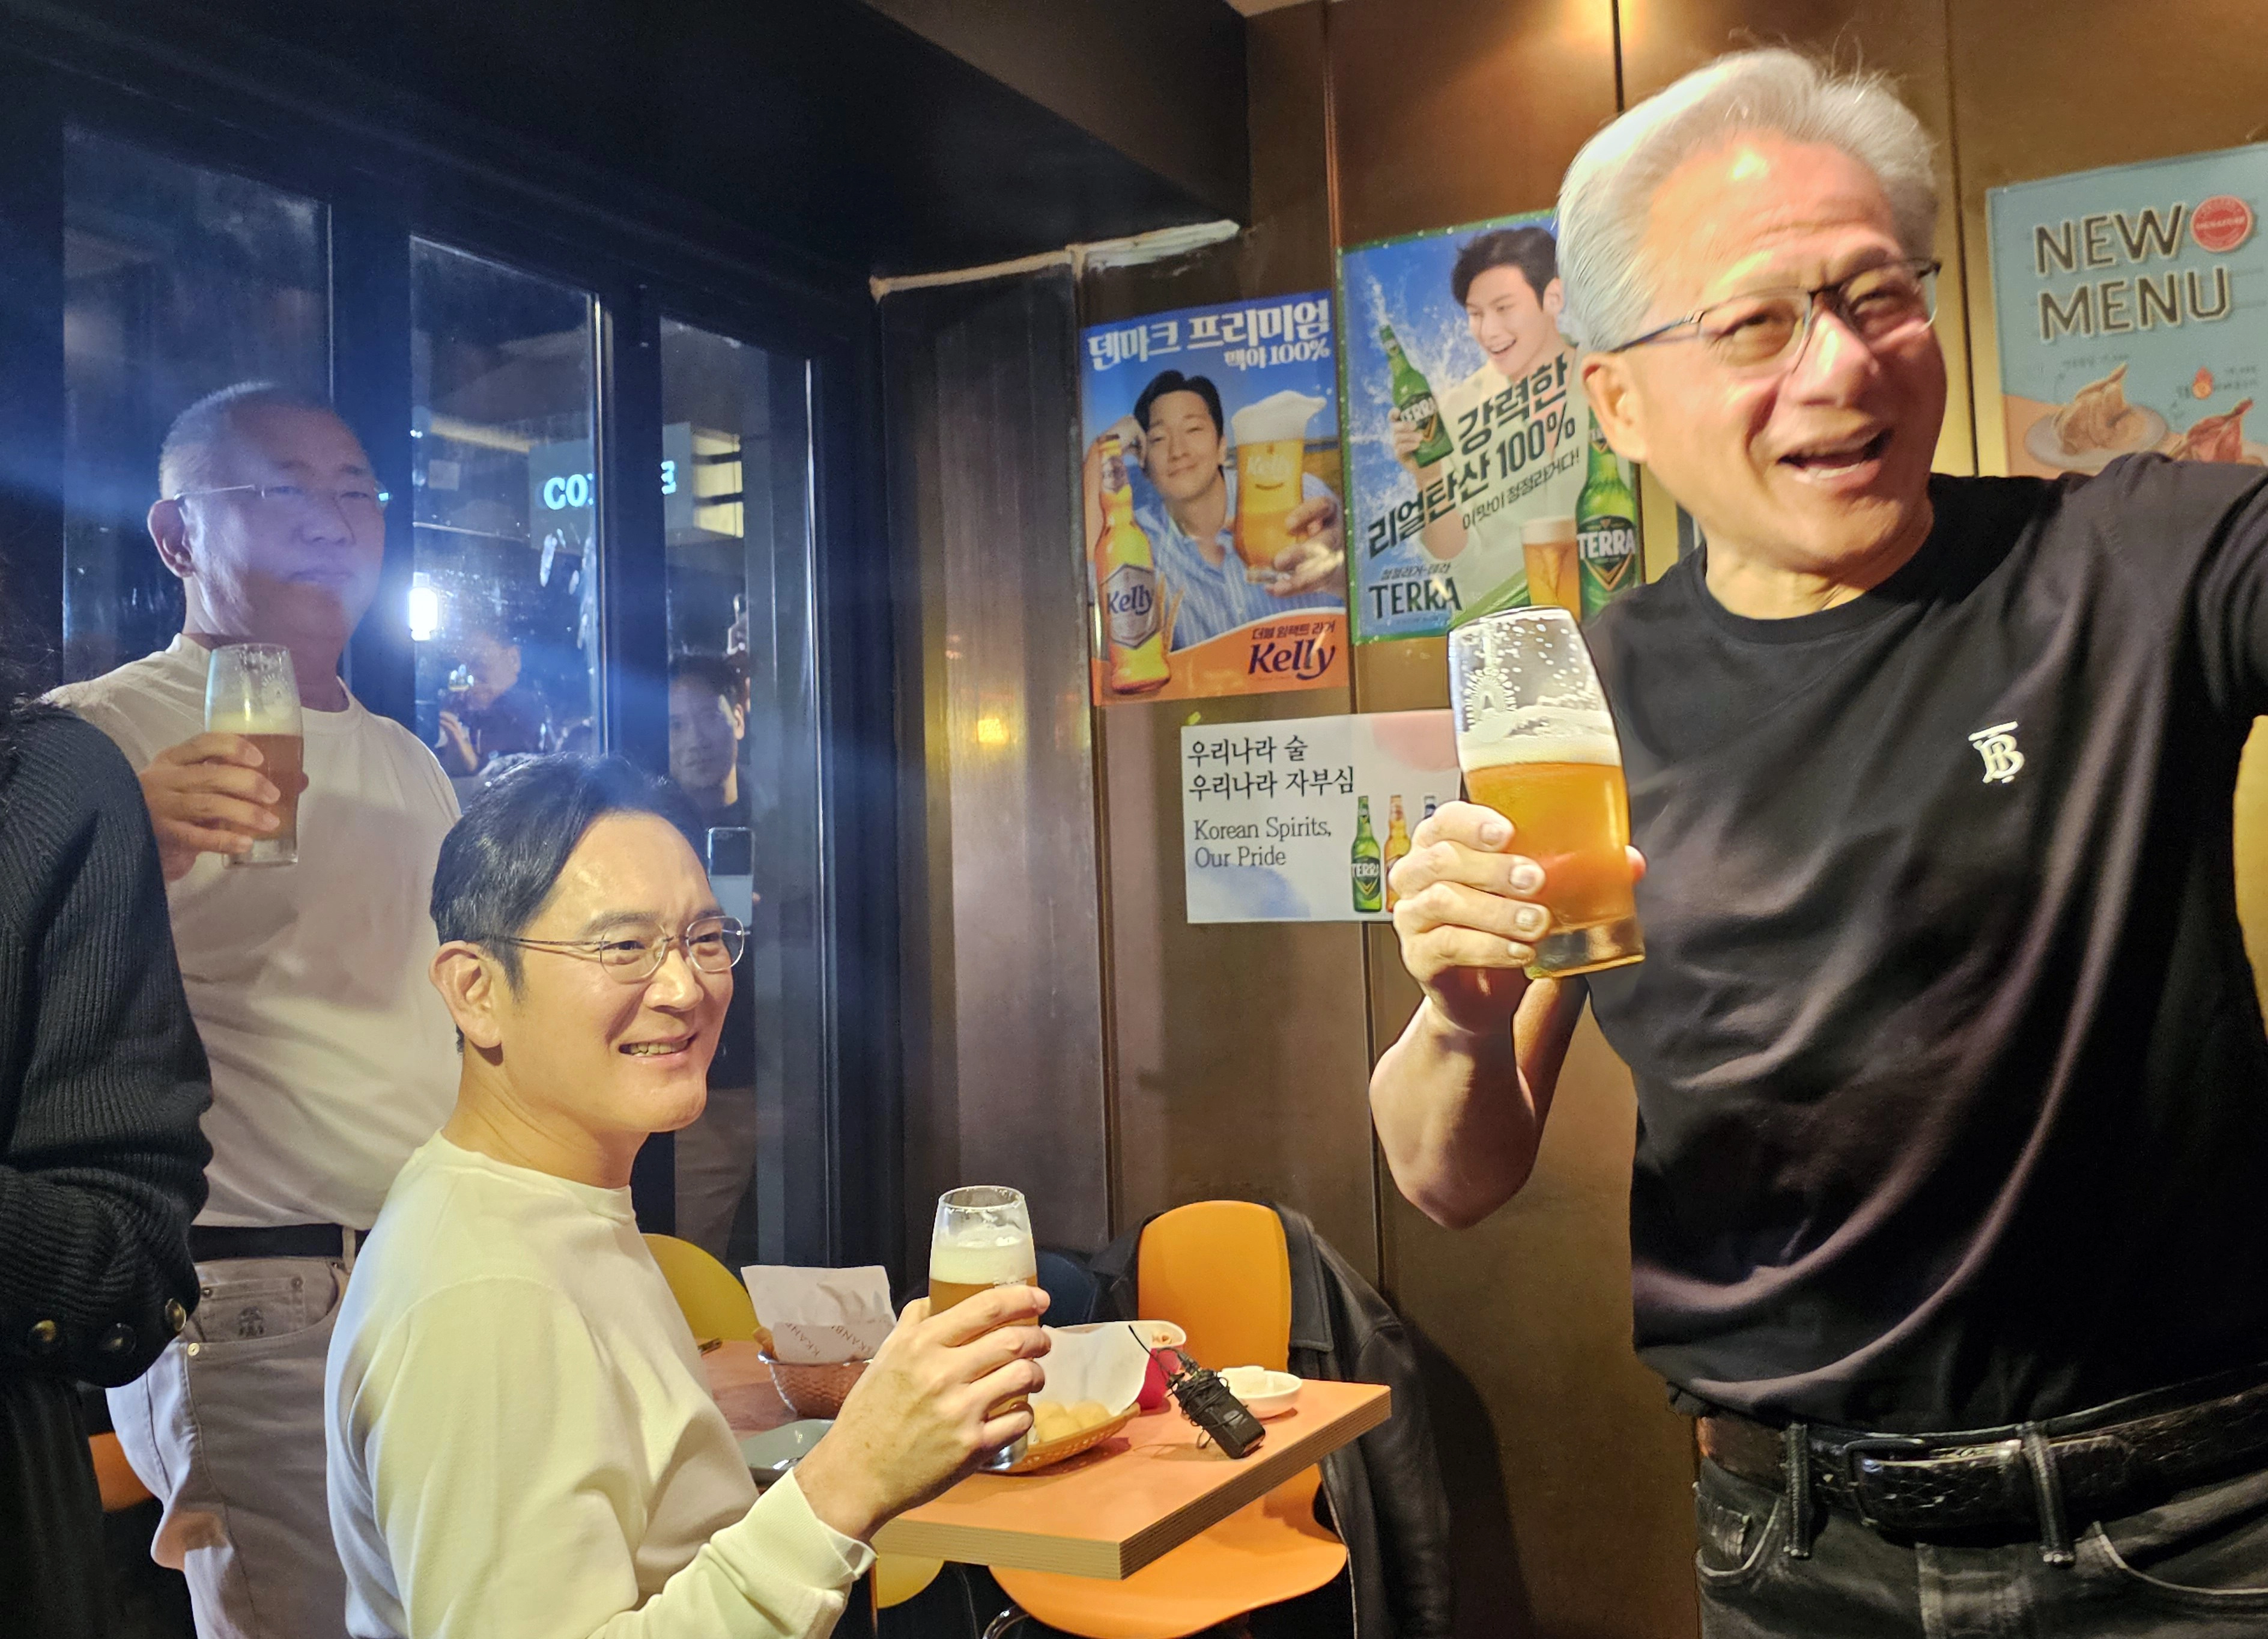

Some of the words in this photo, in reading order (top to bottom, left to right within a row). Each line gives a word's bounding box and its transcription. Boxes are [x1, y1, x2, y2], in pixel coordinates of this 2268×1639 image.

[2034, 203, 2185, 275] NEW
[2039, 266, 2230, 342] MENU
[1087, 320, 1181, 371] 덴마크
[1187, 298, 1329, 347] 프리미엄
[1223, 345, 1266, 371] 맥아
[1268, 338, 1330, 365] 100%
[1458, 352, 1568, 455] 강력한
[1368, 451, 1491, 559] 리얼탄산
[1496, 401, 1575, 479] 100%
[1576, 528, 1636, 560] TERRA
[1107, 584, 1152, 616] Kelly
[1368, 576, 1463, 619] TERRA
[1248, 638, 1336, 680] Kelly
[1187, 737, 1276, 768] 우리나라
[1284, 735, 1308, 762] 술
[1189, 770, 1278, 802] 우리나라
[1285, 766, 1354, 797] 자부심
[1193, 819, 1259, 841] Korean
[1266, 816, 1332, 842] Spirits,
[1195, 847, 1231, 868] Our
[1237, 845, 1287, 867] Pride
